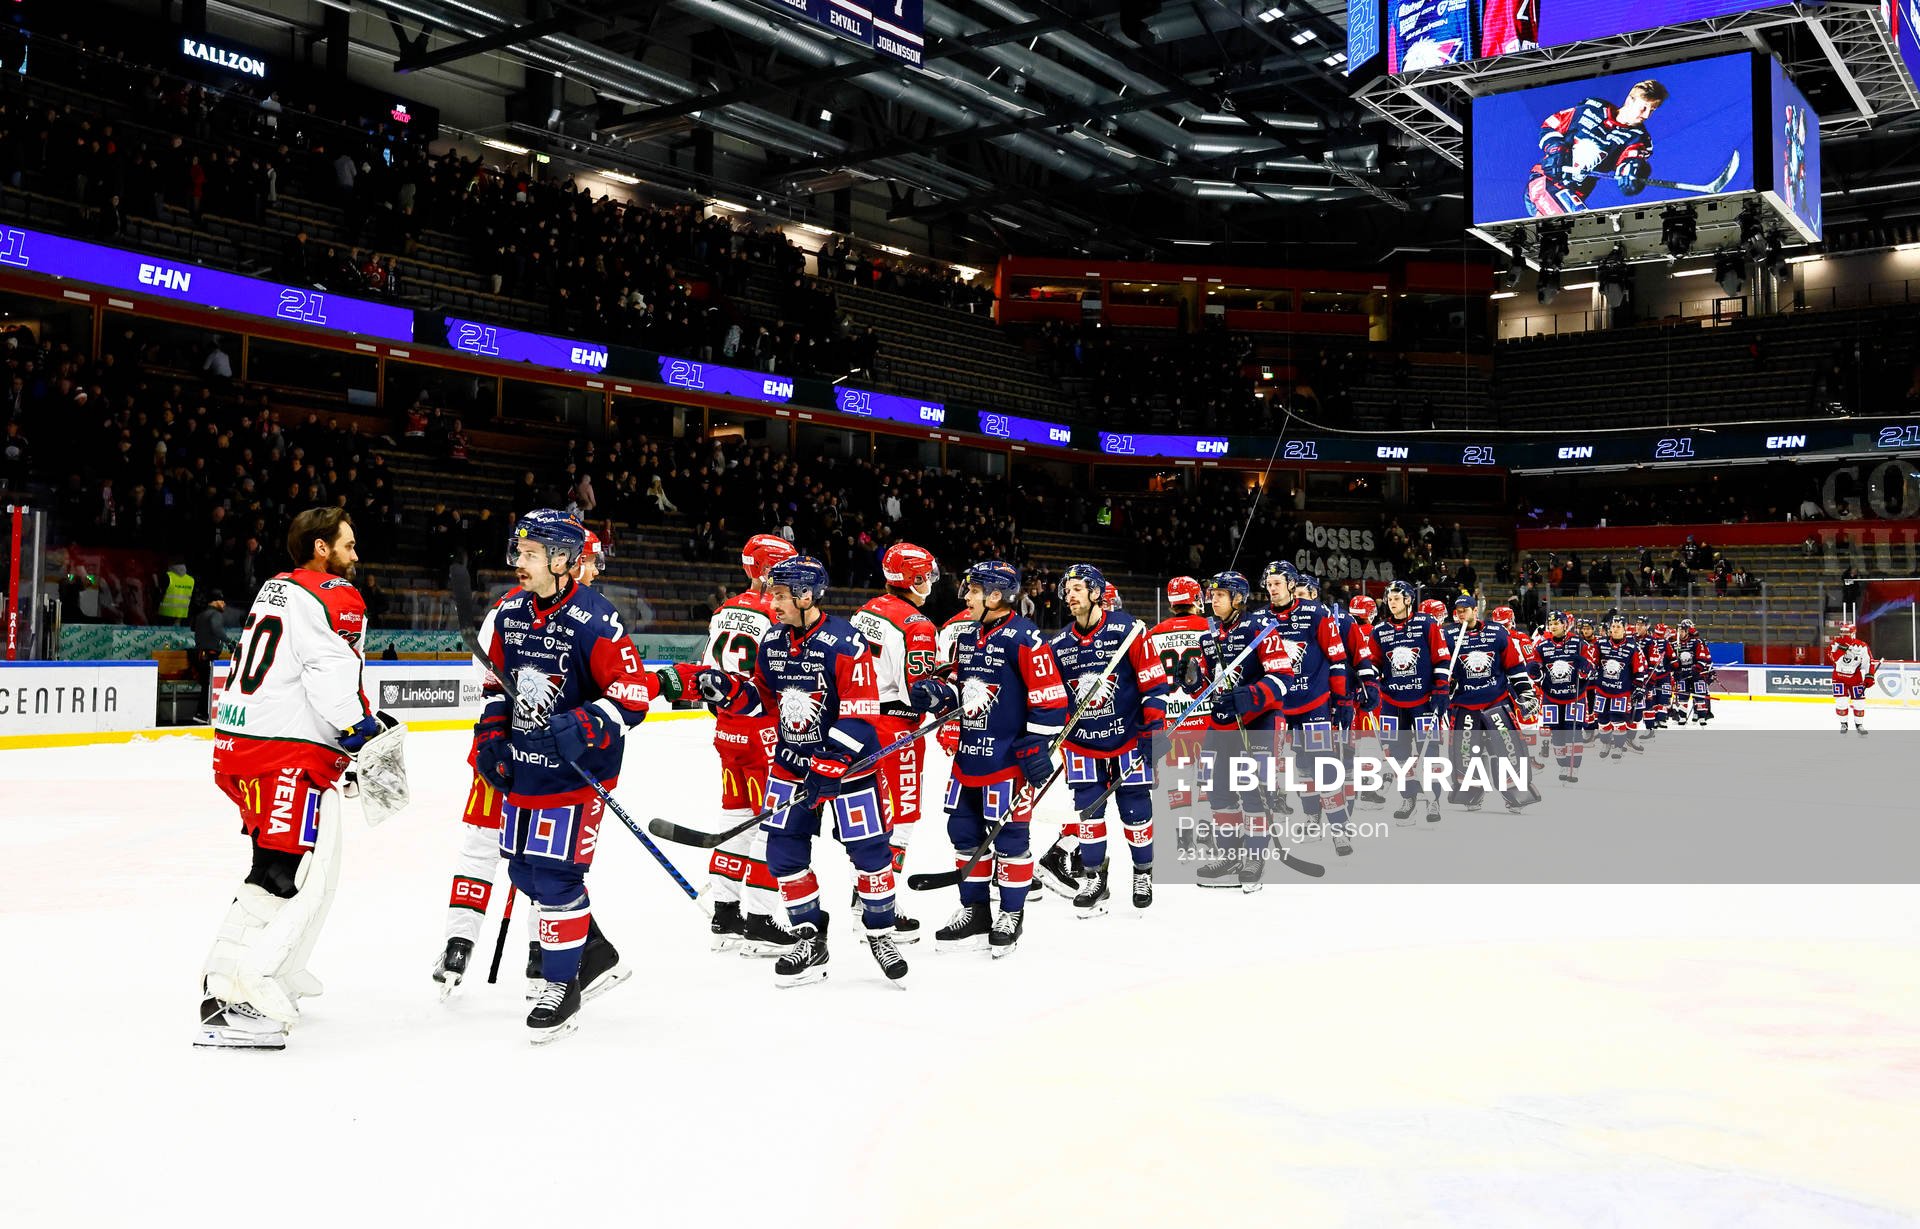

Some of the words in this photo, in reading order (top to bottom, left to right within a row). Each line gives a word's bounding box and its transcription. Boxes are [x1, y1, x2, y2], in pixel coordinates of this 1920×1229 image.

[830, 10, 863, 36] EMVALL
[183, 38, 265, 78] KALLZON
[877, 36, 922, 65] JOHANSSON
[0, 229, 29, 267] 1
[138, 263, 191, 292] EHN
[277, 288, 327, 325] 21
[458, 323, 499, 356] 21
[571, 347, 608, 368] EHN
[669, 361, 704, 389] 21
[763, 380, 794, 399] EHN
[843, 390, 872, 416] 21
[919, 406, 945, 423] EHN
[985, 414, 1010, 437] 21
[1050, 428, 1071, 443] EHN
[1105, 434, 1135, 454] 21
[1766, 435, 1806, 448] EHN
[1876, 425, 1920, 448] 21
[1196, 440, 1228, 453] EHN
[1284, 441, 1318, 459] 21
[1377, 446, 1408, 459] EHN
[1463, 446, 1496, 465] 21
[1558, 446, 1593, 459] EHN
[1655, 438, 1695, 458] 21
[1305, 520, 1375, 552] BOSSES
[1295, 548, 1395, 582] GLASSBAR
[264, 582, 288, 595] ORDIC
[566, 604, 593, 625] MAXI
[726, 611, 755, 624] NORDIC
[859, 614, 881, 630] NORDIC
[8, 612, 17, 649] RAITA
[1106, 623, 1126, 633] MAXI
[1165, 633, 1196, 641] NORDIC
[816, 630, 838, 647] MAXI
[1103, 639, 1119, 647] SAAB
[1262, 634, 1284, 655] 22
[559, 652, 570, 673] C
[620, 646, 638, 674] 5
[809, 650, 825, 658] SAAB
[907, 650, 936, 676] 55
[850, 662, 872, 687] 41
[1032, 654, 1055, 678] 37
[817, 672, 828, 690] A
[401, 687, 455, 702] Linköping
[1028, 687, 1056, 704] SMG
[839, 700, 870, 716] SMG
[1113, 717, 1124, 727] IT
[982, 737, 995, 747] IT
[899, 748, 917, 817] STENA
[267, 767, 303, 835] STENA
[1079, 824, 1094, 834] BC
[1132, 830, 1149, 840] BC
[869, 875, 888, 886] BC
[870, 883, 889, 893] BYGG
[540, 920, 559, 935] BC
